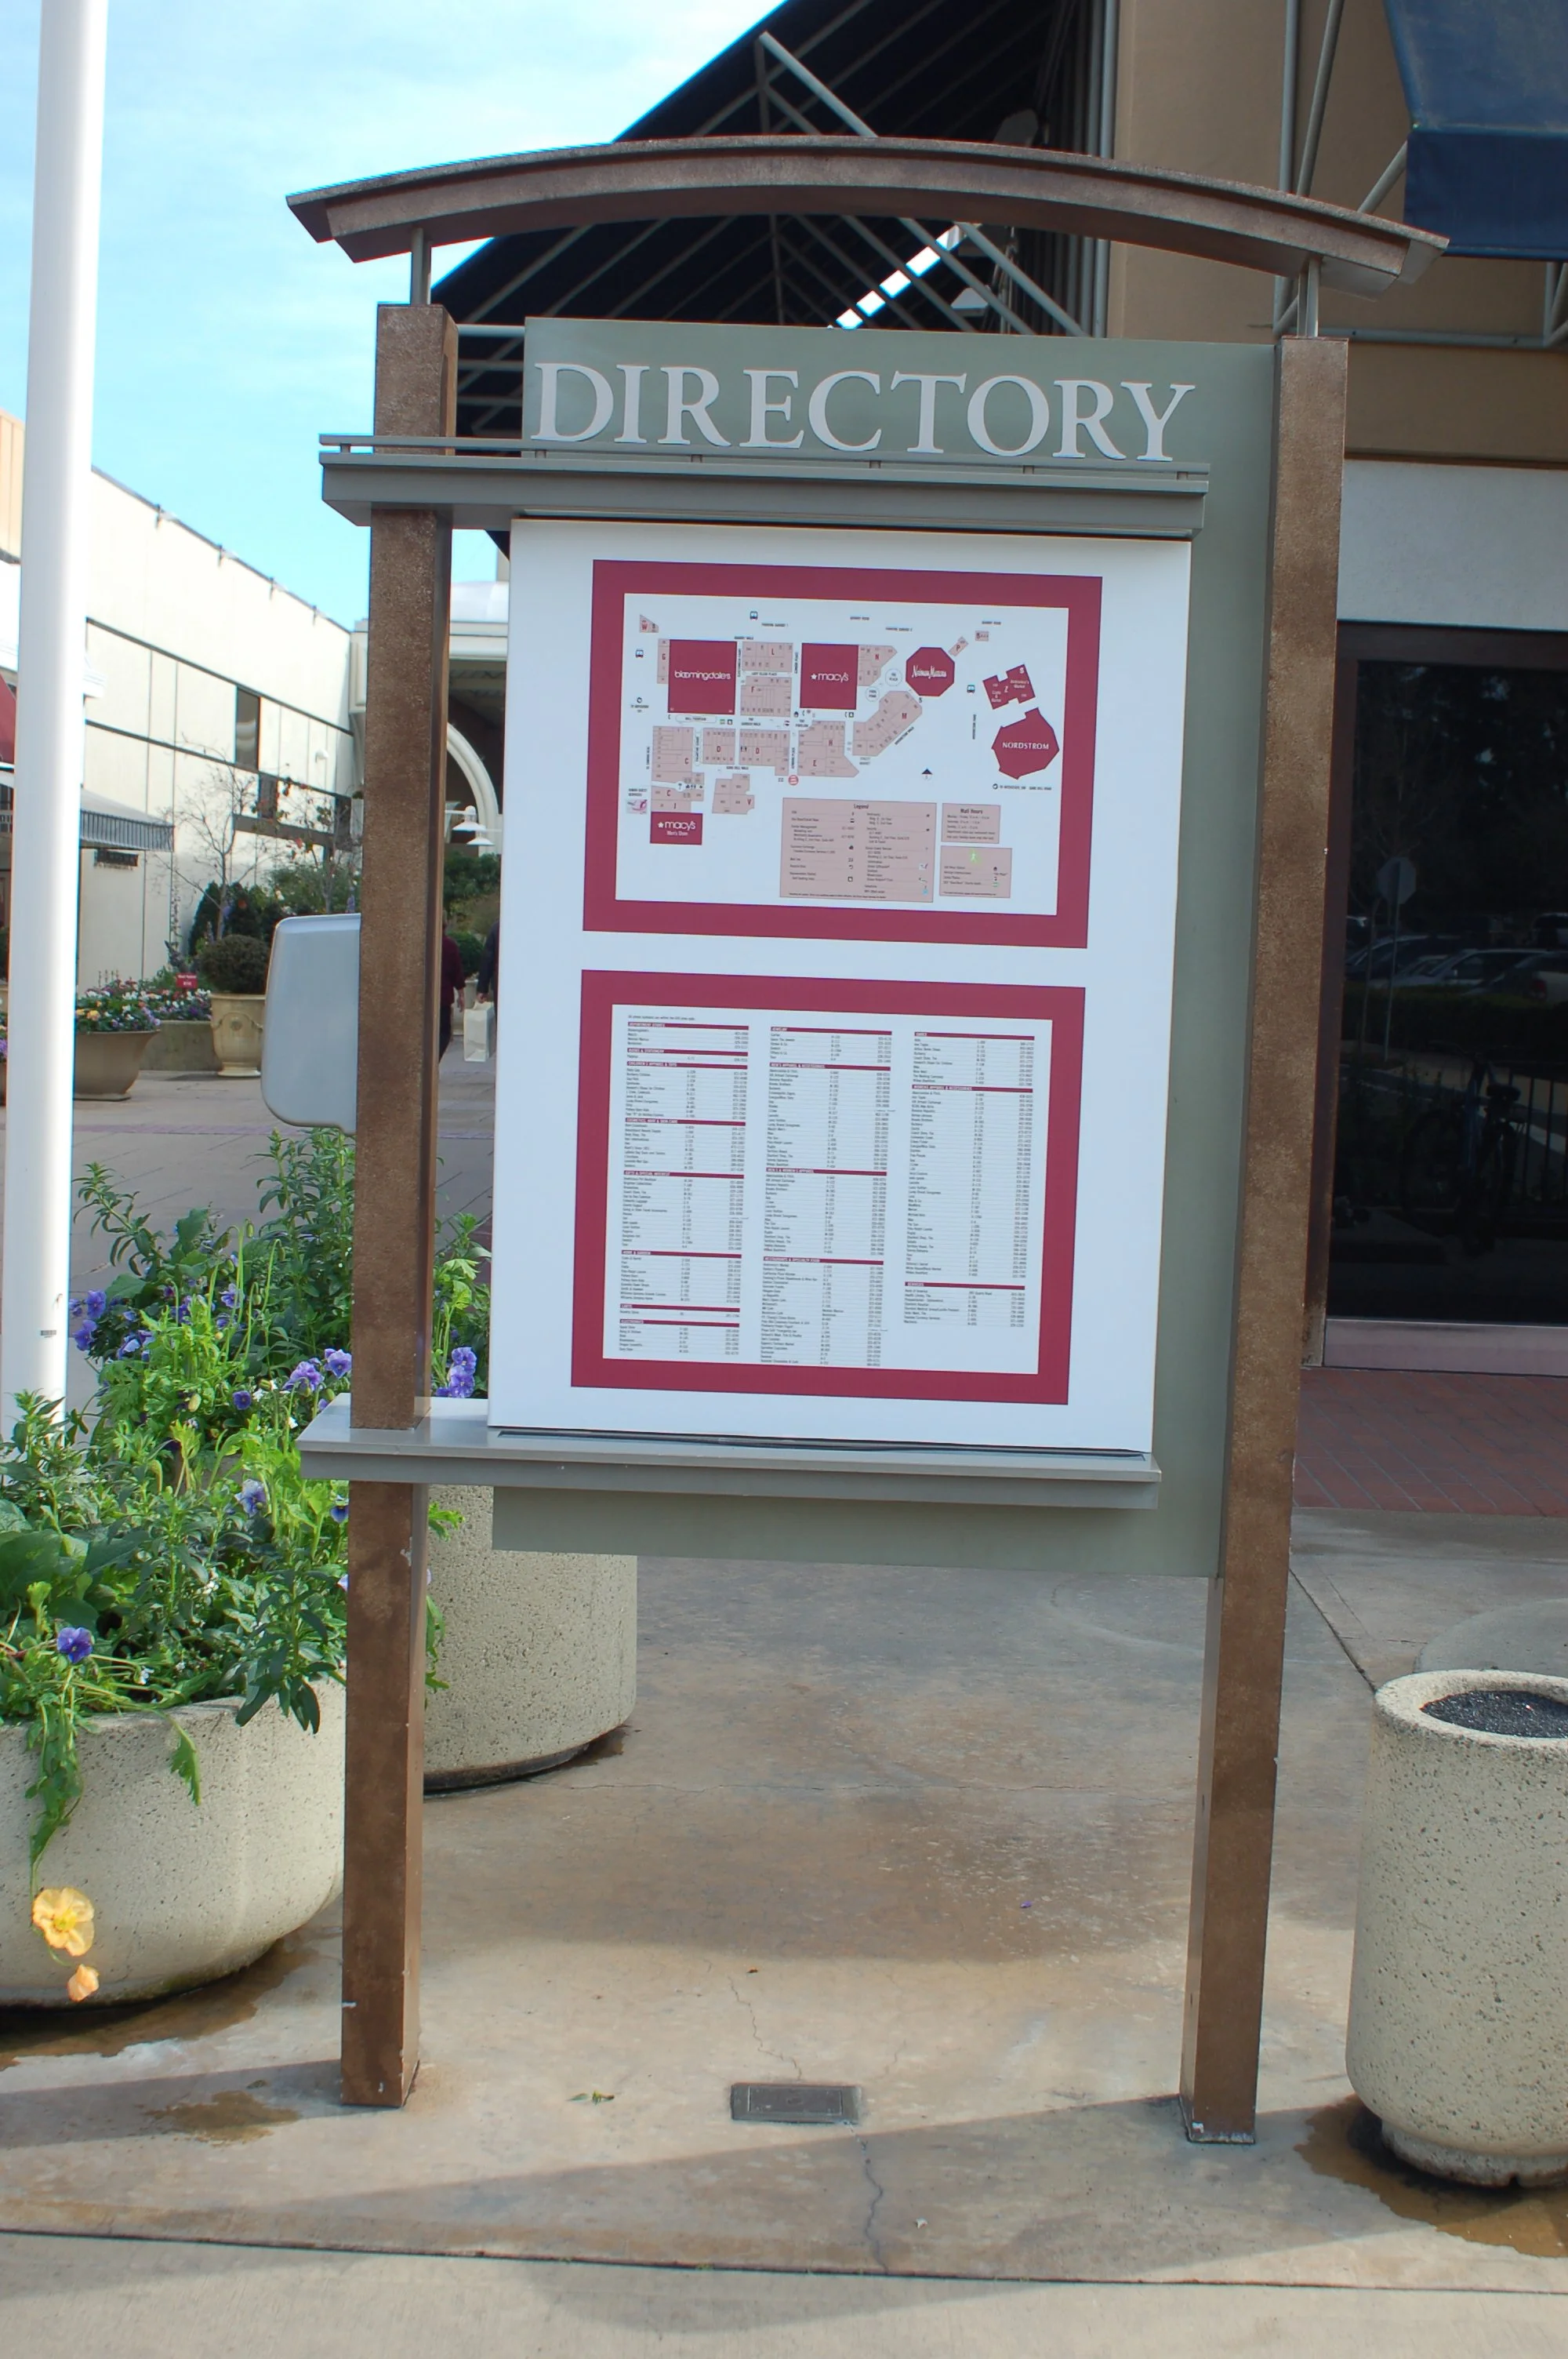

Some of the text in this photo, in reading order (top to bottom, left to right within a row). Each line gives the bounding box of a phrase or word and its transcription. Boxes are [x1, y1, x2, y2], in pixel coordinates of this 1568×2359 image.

[531, 362, 1195, 461] DIRECTORY
[818, 672, 849, 683] macy's
[665, 821, 696, 831] macy's
